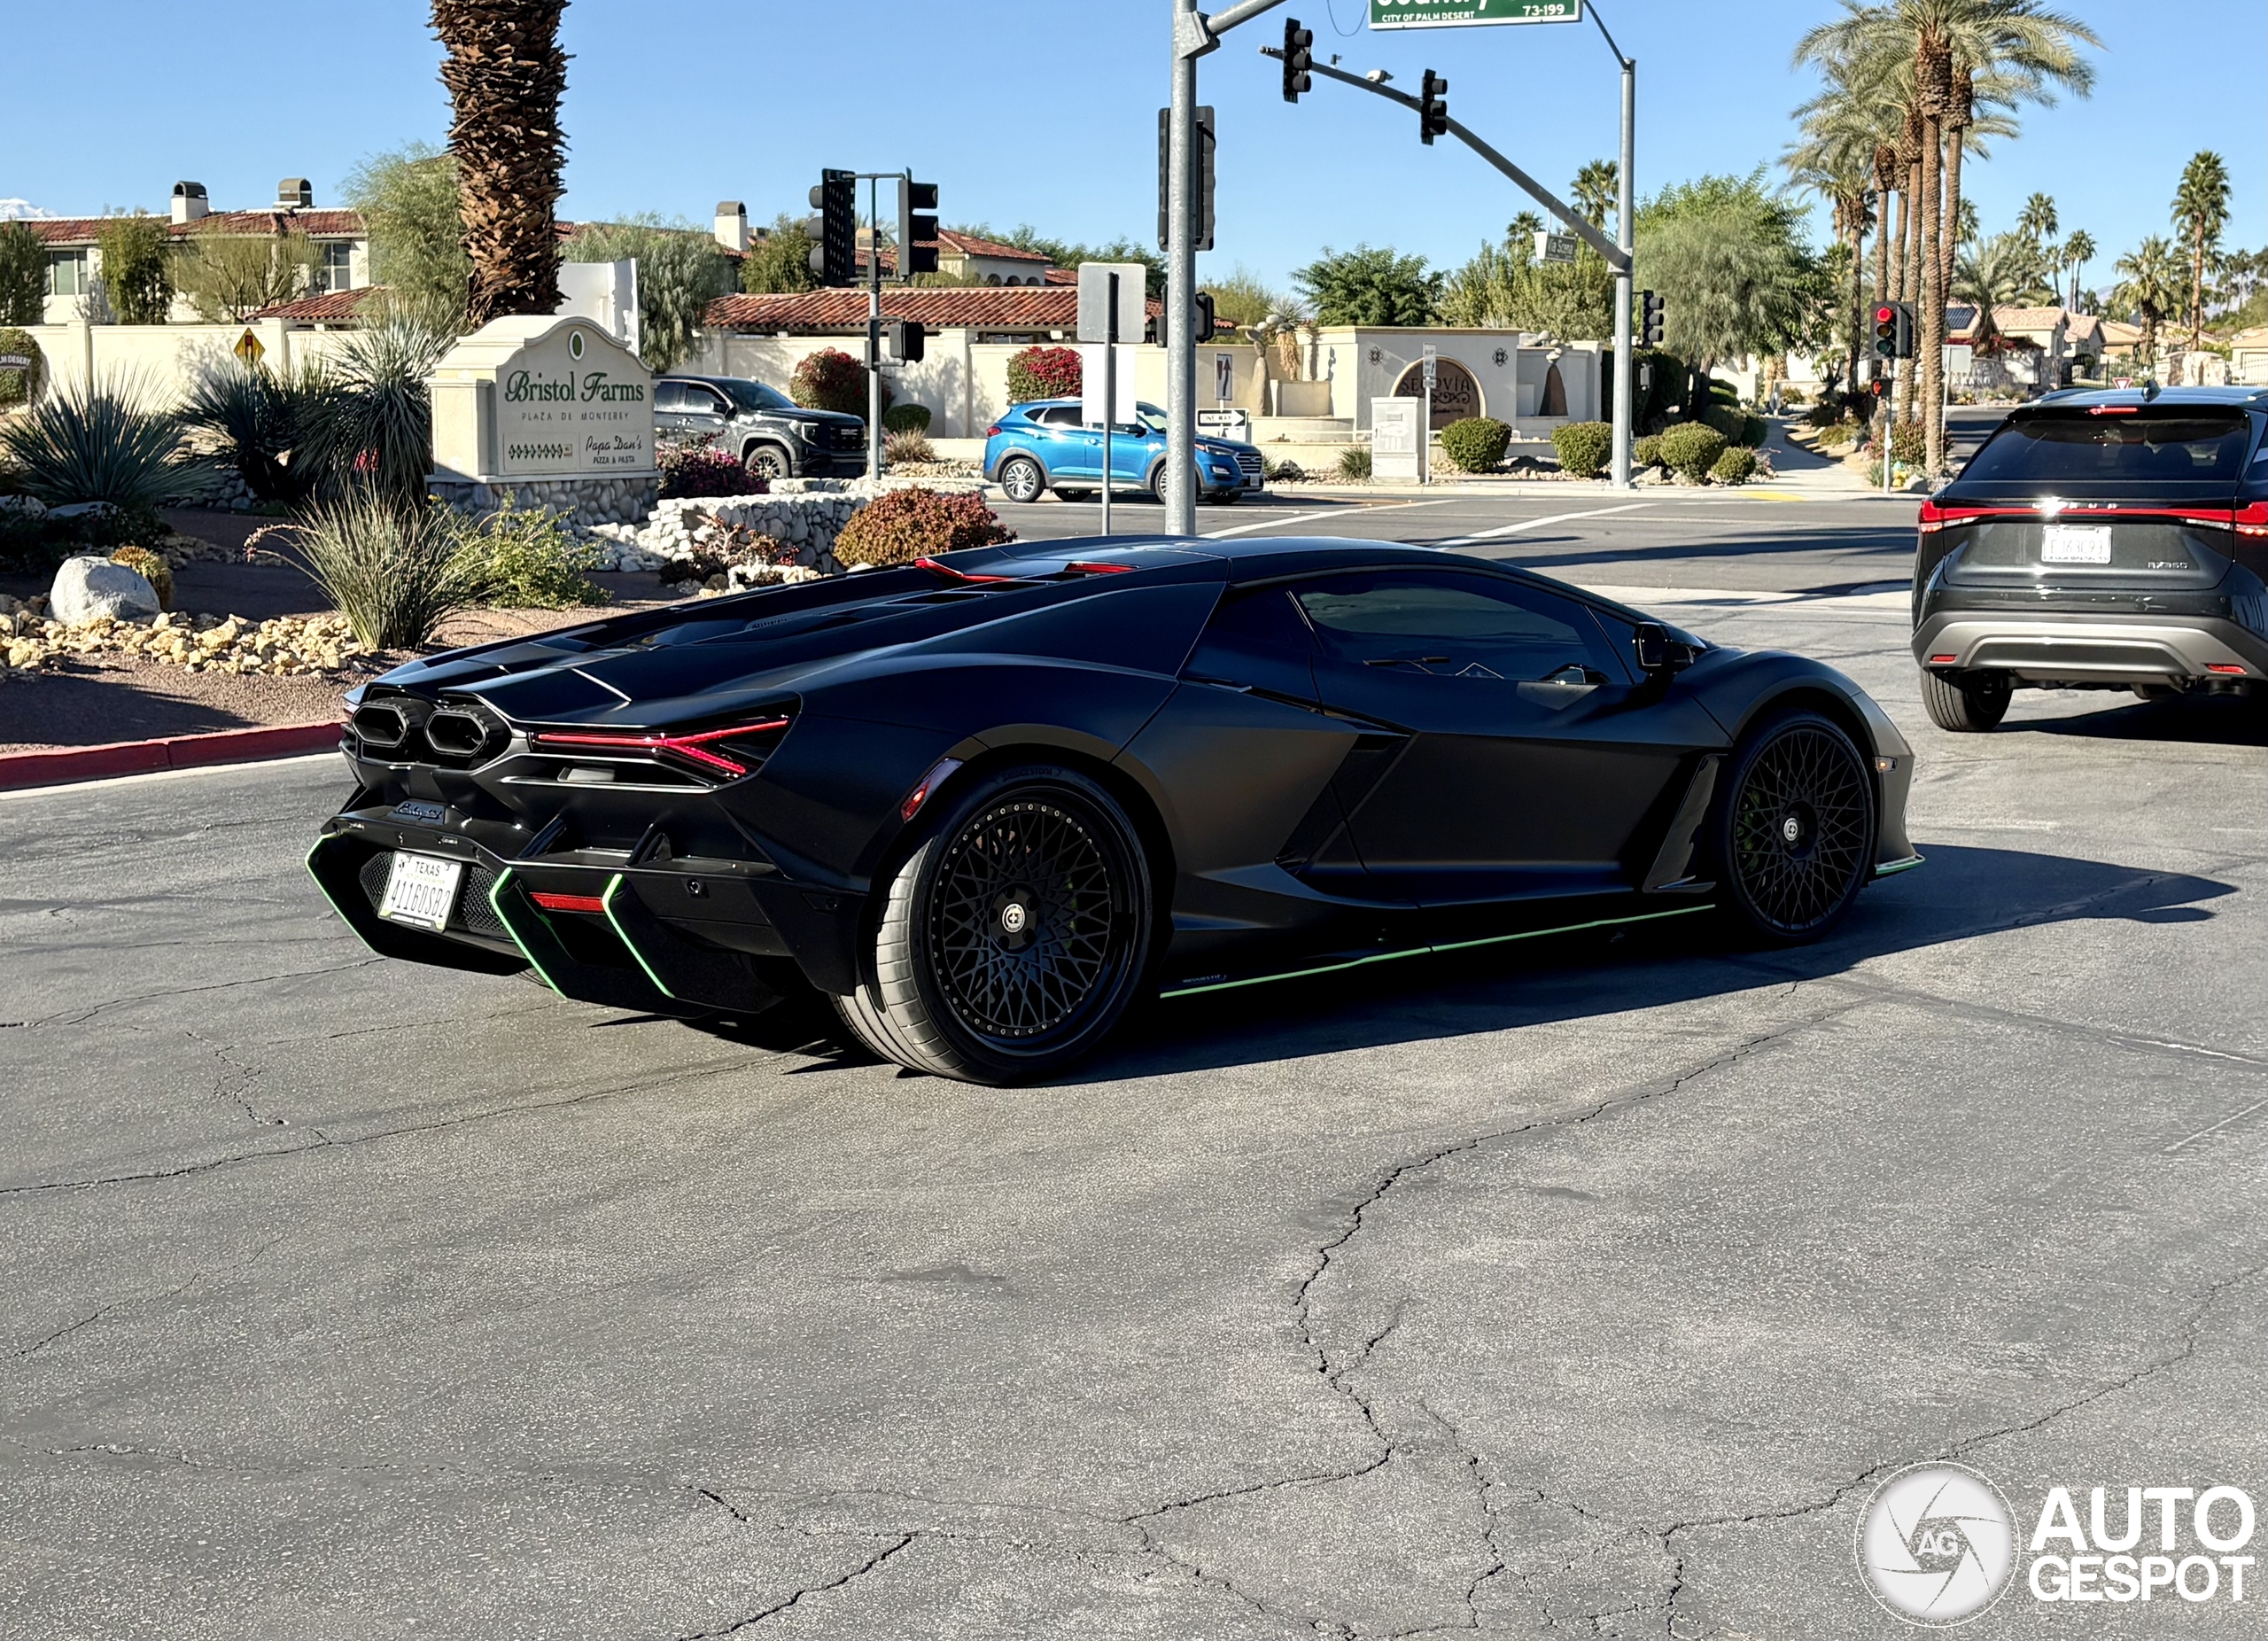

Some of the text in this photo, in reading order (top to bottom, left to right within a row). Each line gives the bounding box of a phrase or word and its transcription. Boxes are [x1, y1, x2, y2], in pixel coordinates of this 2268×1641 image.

[1441, 11, 1475, 20] DESERT
[1522, 4, 1565, 17] 73-199
[504, 369, 644, 402] Bristol Farms
[1401, 375, 1471, 392] SEOVIA
[522, 411, 629, 421] PLAZA DE MONTEREY
[586, 435, 610, 455] Papa
[613, 434, 642, 452] Dan's
[415, 860, 441, 877] TEXAS
